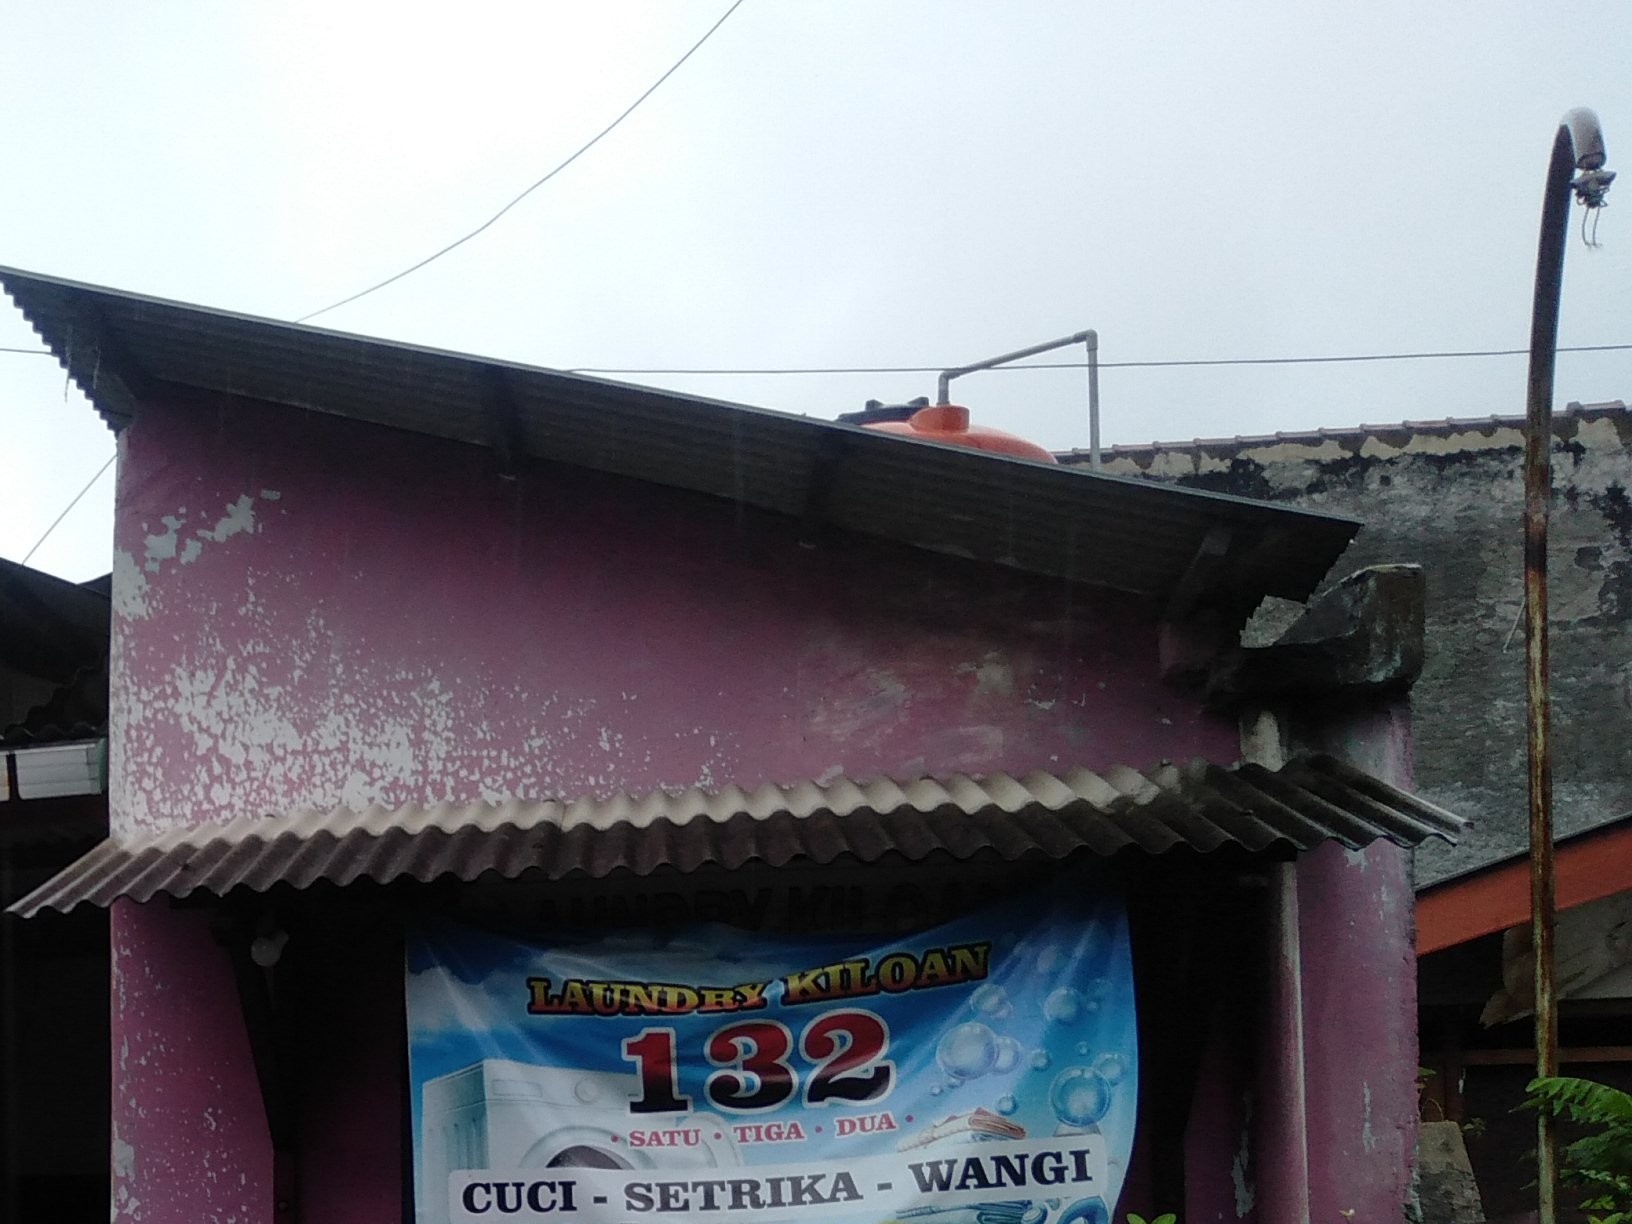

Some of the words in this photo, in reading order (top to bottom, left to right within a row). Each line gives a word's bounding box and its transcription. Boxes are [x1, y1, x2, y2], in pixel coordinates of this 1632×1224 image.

[528, 976, 766, 1015] LAUNDRY
[781, 944, 991, 1006] KILOAN
[621, 1008, 896, 1116] 132
[629, 1127, 701, 1149] SATU
[733, 1120, 805, 1145] TIGA
[836, 1113, 896, 1137] DUA
[461, 1180, 577, 1215] CUCI
[624, 1170, 864, 1213] SETRIKA
[909, 1148, 1093, 1195] WANGI
